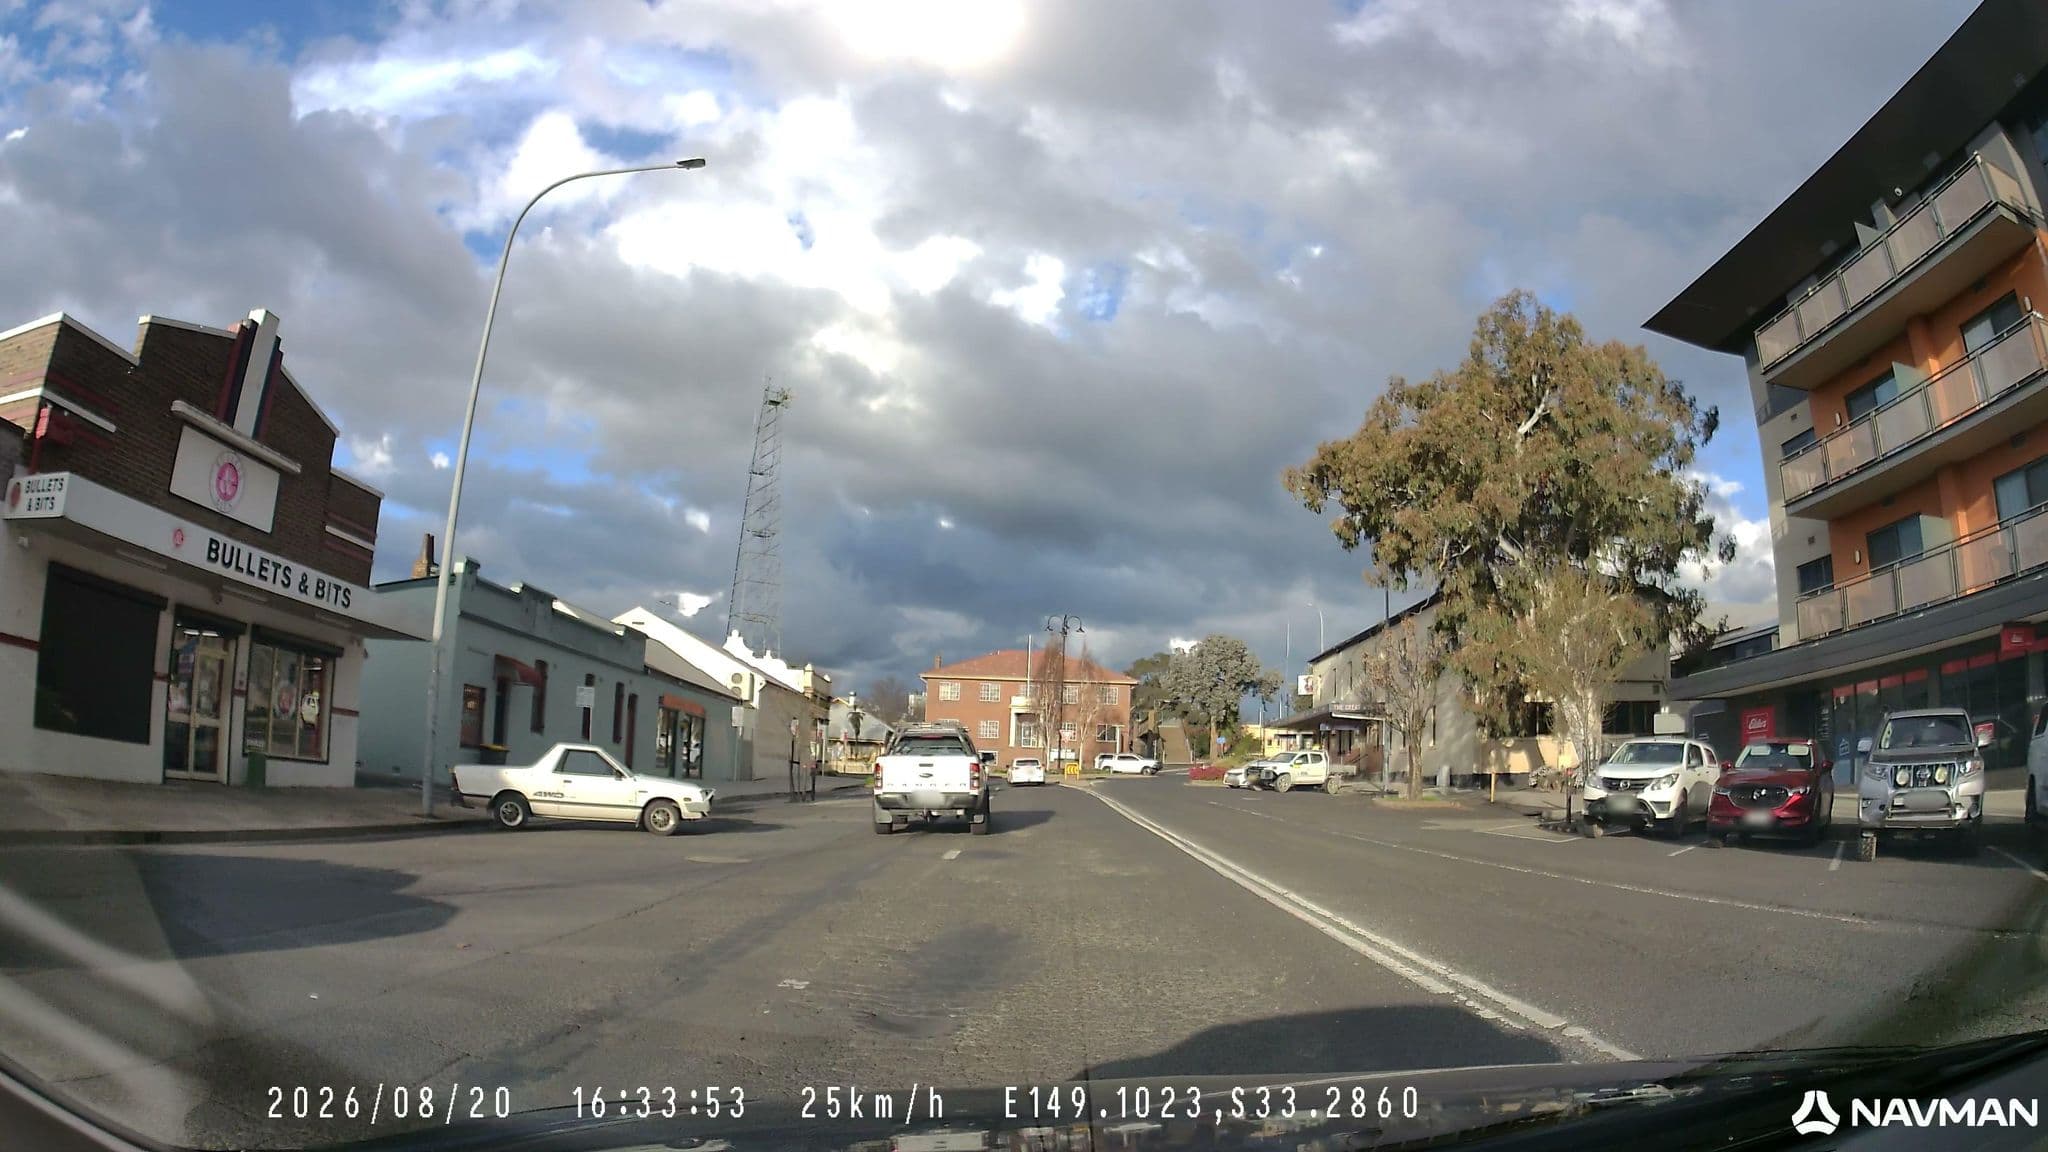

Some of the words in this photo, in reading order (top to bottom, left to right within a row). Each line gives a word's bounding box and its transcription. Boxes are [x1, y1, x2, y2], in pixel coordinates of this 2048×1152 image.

[25, 478, 64, 493] BULLETS
[35, 497, 55, 510] BITS
[206, 537, 292, 589] BULLETS
[298, 572, 309, 595] &
[315, 578, 352, 608] BITS
